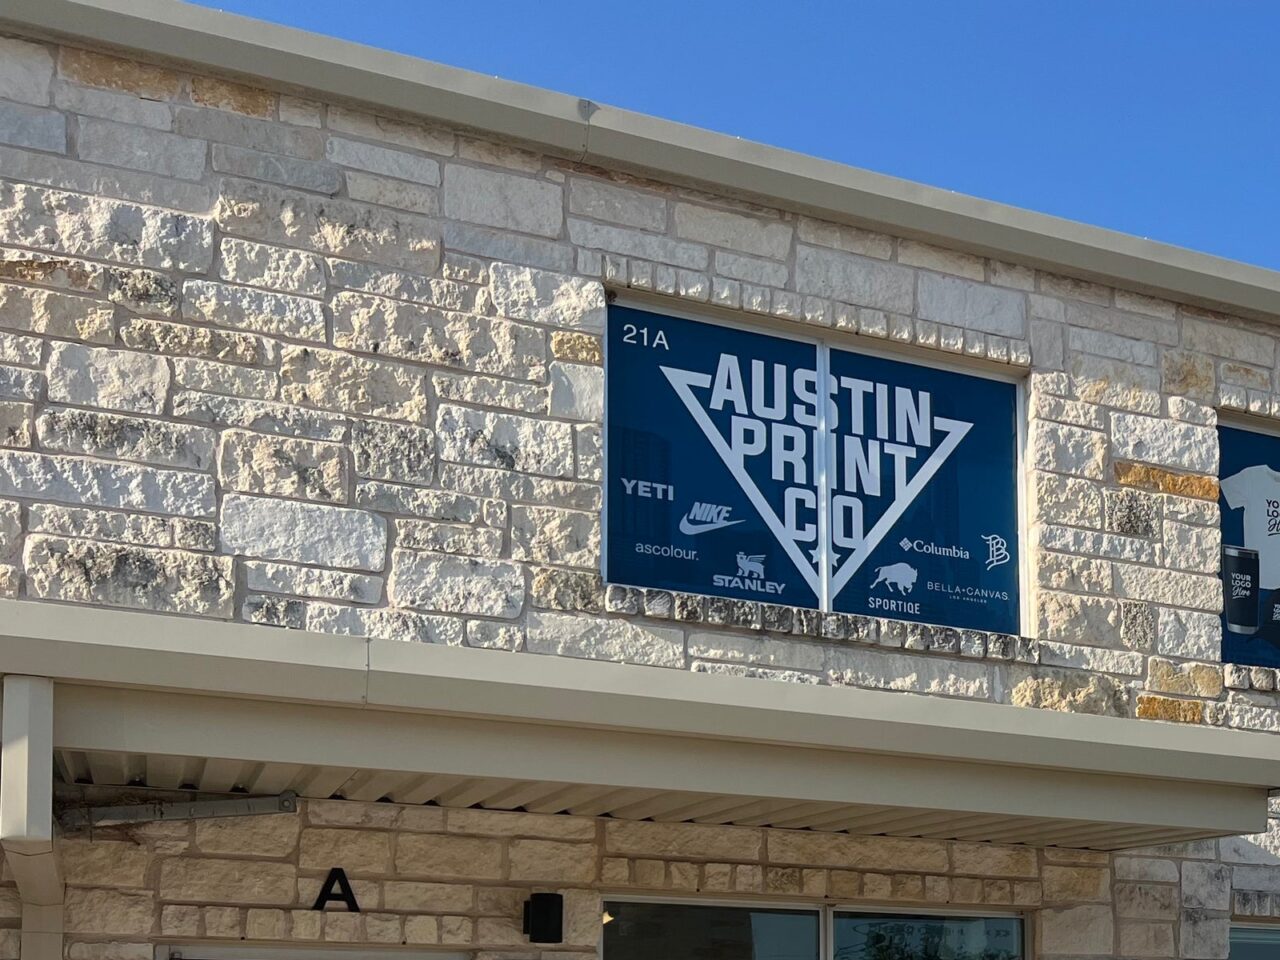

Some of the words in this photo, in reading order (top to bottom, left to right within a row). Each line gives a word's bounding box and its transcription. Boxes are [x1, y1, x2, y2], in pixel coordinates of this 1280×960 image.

[623, 324, 670, 351] 21A
[709, 353, 932, 447] AUSTIN
[731, 415, 917, 502] PRINT
[620, 477, 674, 501] YETI
[688, 502, 733, 523] NIKE
[784, 487, 864, 549] CO
[913, 539, 970, 560] Columbia
[713, 574, 786, 595] STANLEY
[1231, 572, 1252, 582] YOUR
[1231, 579, 1252, 588] LOGO
[868, 596, 921, 615] SPORTIQE
[311, 867, 361, 913] A
